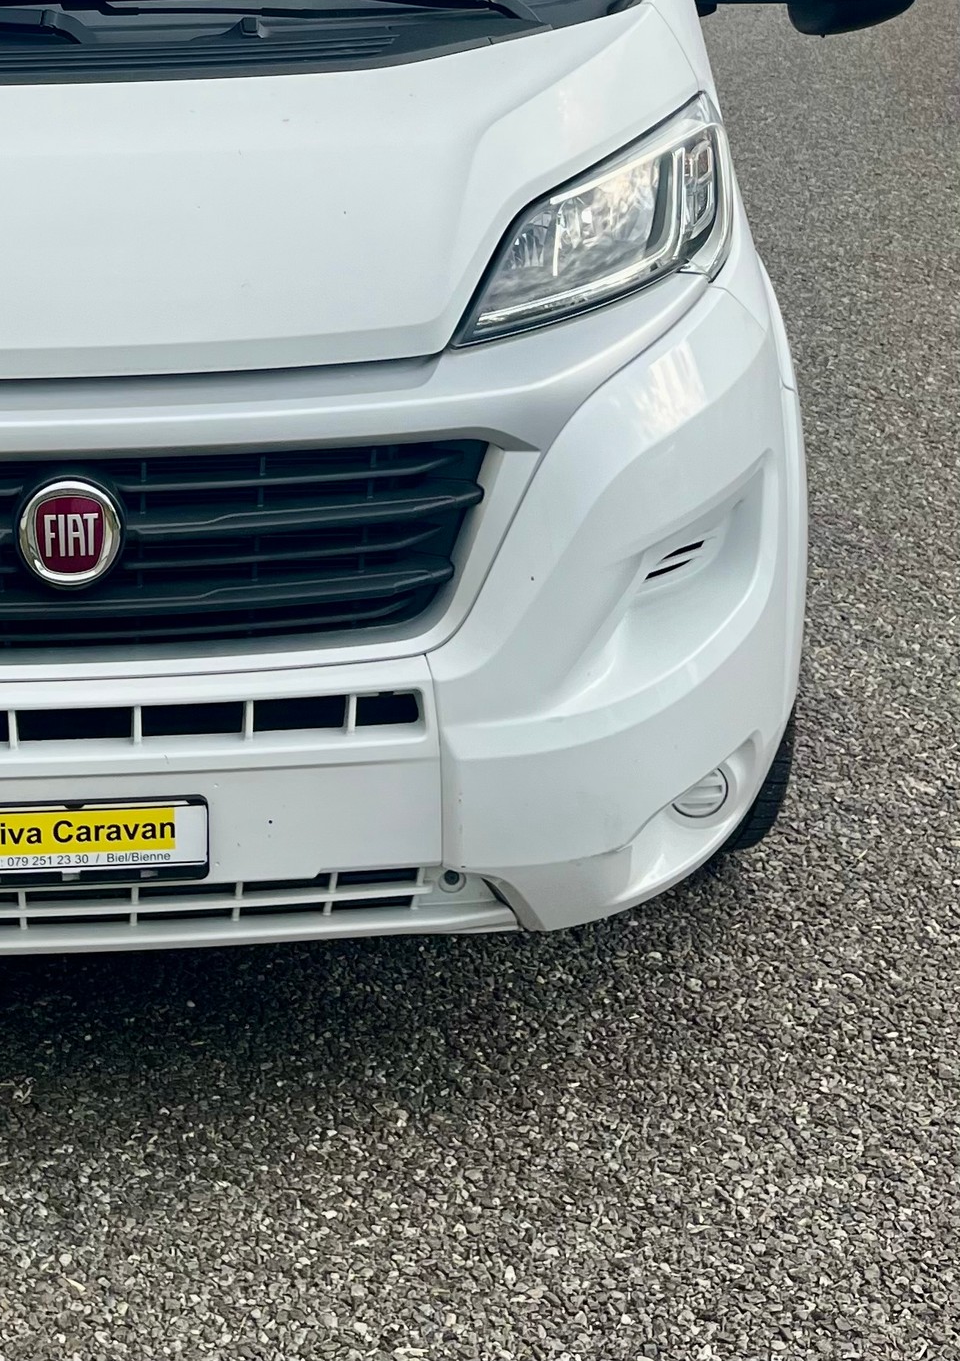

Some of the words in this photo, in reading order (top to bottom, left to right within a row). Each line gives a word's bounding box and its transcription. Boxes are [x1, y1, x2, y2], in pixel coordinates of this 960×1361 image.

[43, 512, 99, 557] FIAT
[52, 819, 176, 844] Caravan
[7, 855, 29, 867] 079
[32, 855, 53, 866] 251
[57, 854, 72, 865] 23
[74, 854, 90, 865] 30
[106, 850, 172, 863] Biel/Bienne
